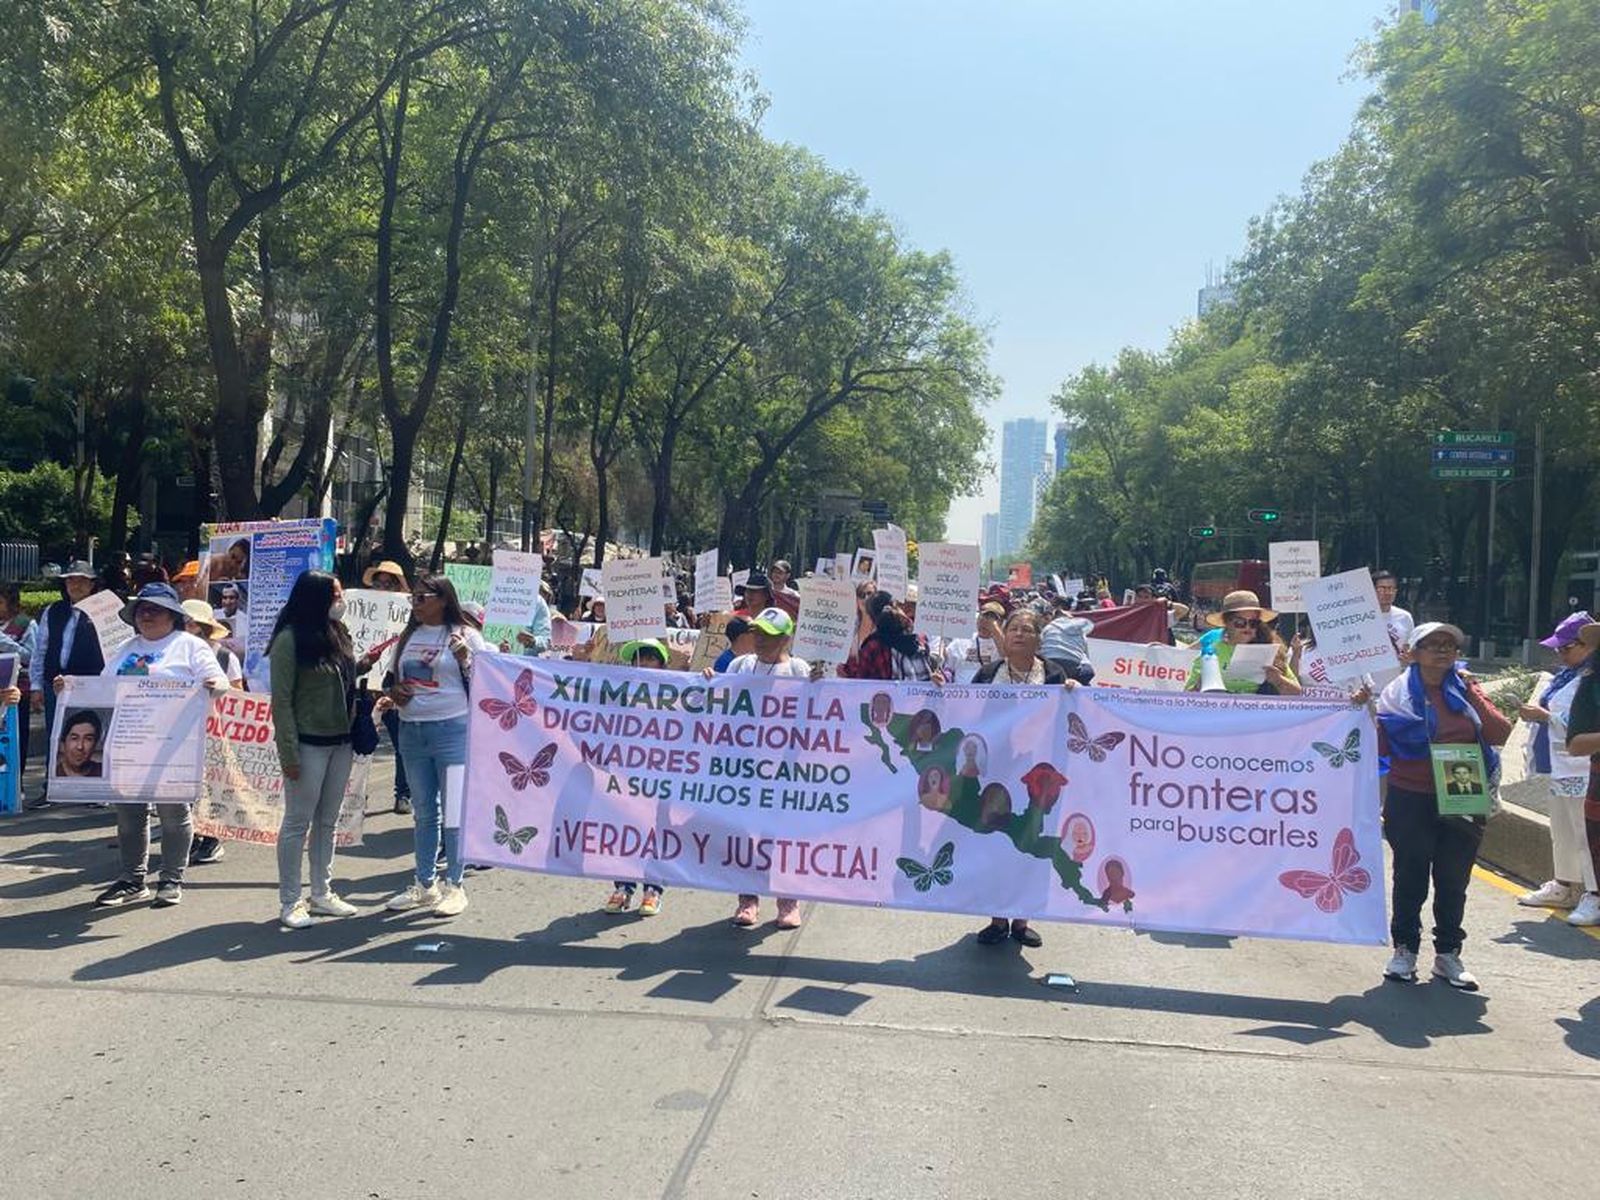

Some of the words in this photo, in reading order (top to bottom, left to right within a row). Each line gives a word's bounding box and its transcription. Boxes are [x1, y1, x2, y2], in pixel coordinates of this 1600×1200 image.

[607, 586, 658, 598] FRONTERAS
[1316, 610, 1377, 631] FRONTERAS
[1137, 660, 1190, 682] fuera
[549, 674, 591, 703] XII
[599, 679, 755, 718] MARCHA
[760, 694, 798, 719] DE
[806, 697, 846, 722] LA
[1111, 693, 1163, 706] Monumento
[1187, 698, 1218, 709] Madre
[543, 706, 684, 743] DIGNIDAD
[693, 721, 851, 755] NACIONAL
[580, 739, 701, 775] MADRES
[708, 756, 852, 785] BUSCANDO
[1128, 734, 1186, 770] No
[1190, 751, 1316, 775] conocemos
[606, 774, 622, 794] A
[627, 775, 672, 800] SUS
[680, 782, 752, 807] HIJOS
[759, 787, 775, 809] E
[781, 789, 851, 814] HIJAS
[1128, 772, 1319, 815] fronteras
[553, 819, 683, 861] ¡VERDAD
[687, 832, 710, 866] Y
[721, 836, 879, 881] JUSTICIA!
[1129, 815, 1174, 834] para
[1177, 815, 1319, 849] buscarles
